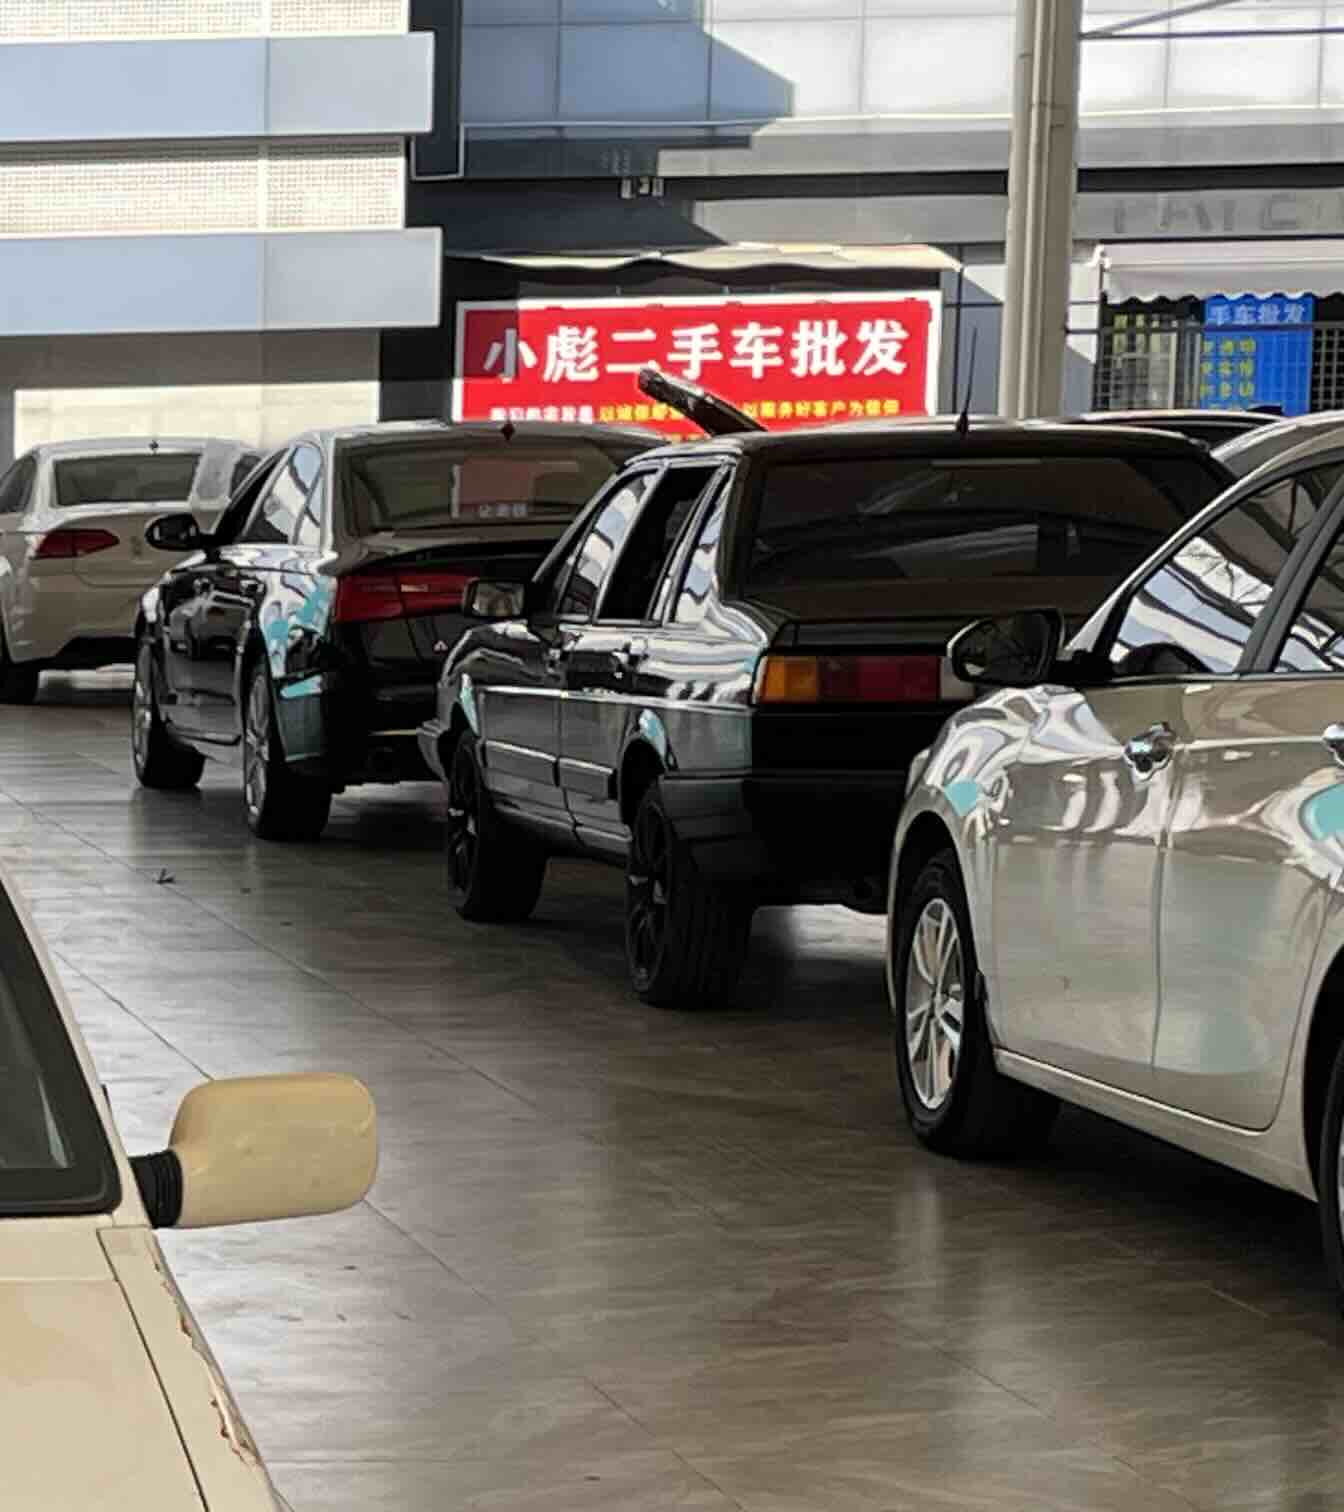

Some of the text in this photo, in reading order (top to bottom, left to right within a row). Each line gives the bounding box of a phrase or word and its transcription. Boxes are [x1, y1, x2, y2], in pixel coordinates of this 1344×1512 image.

[483, 318, 909, 384] 小彪二手车批发
